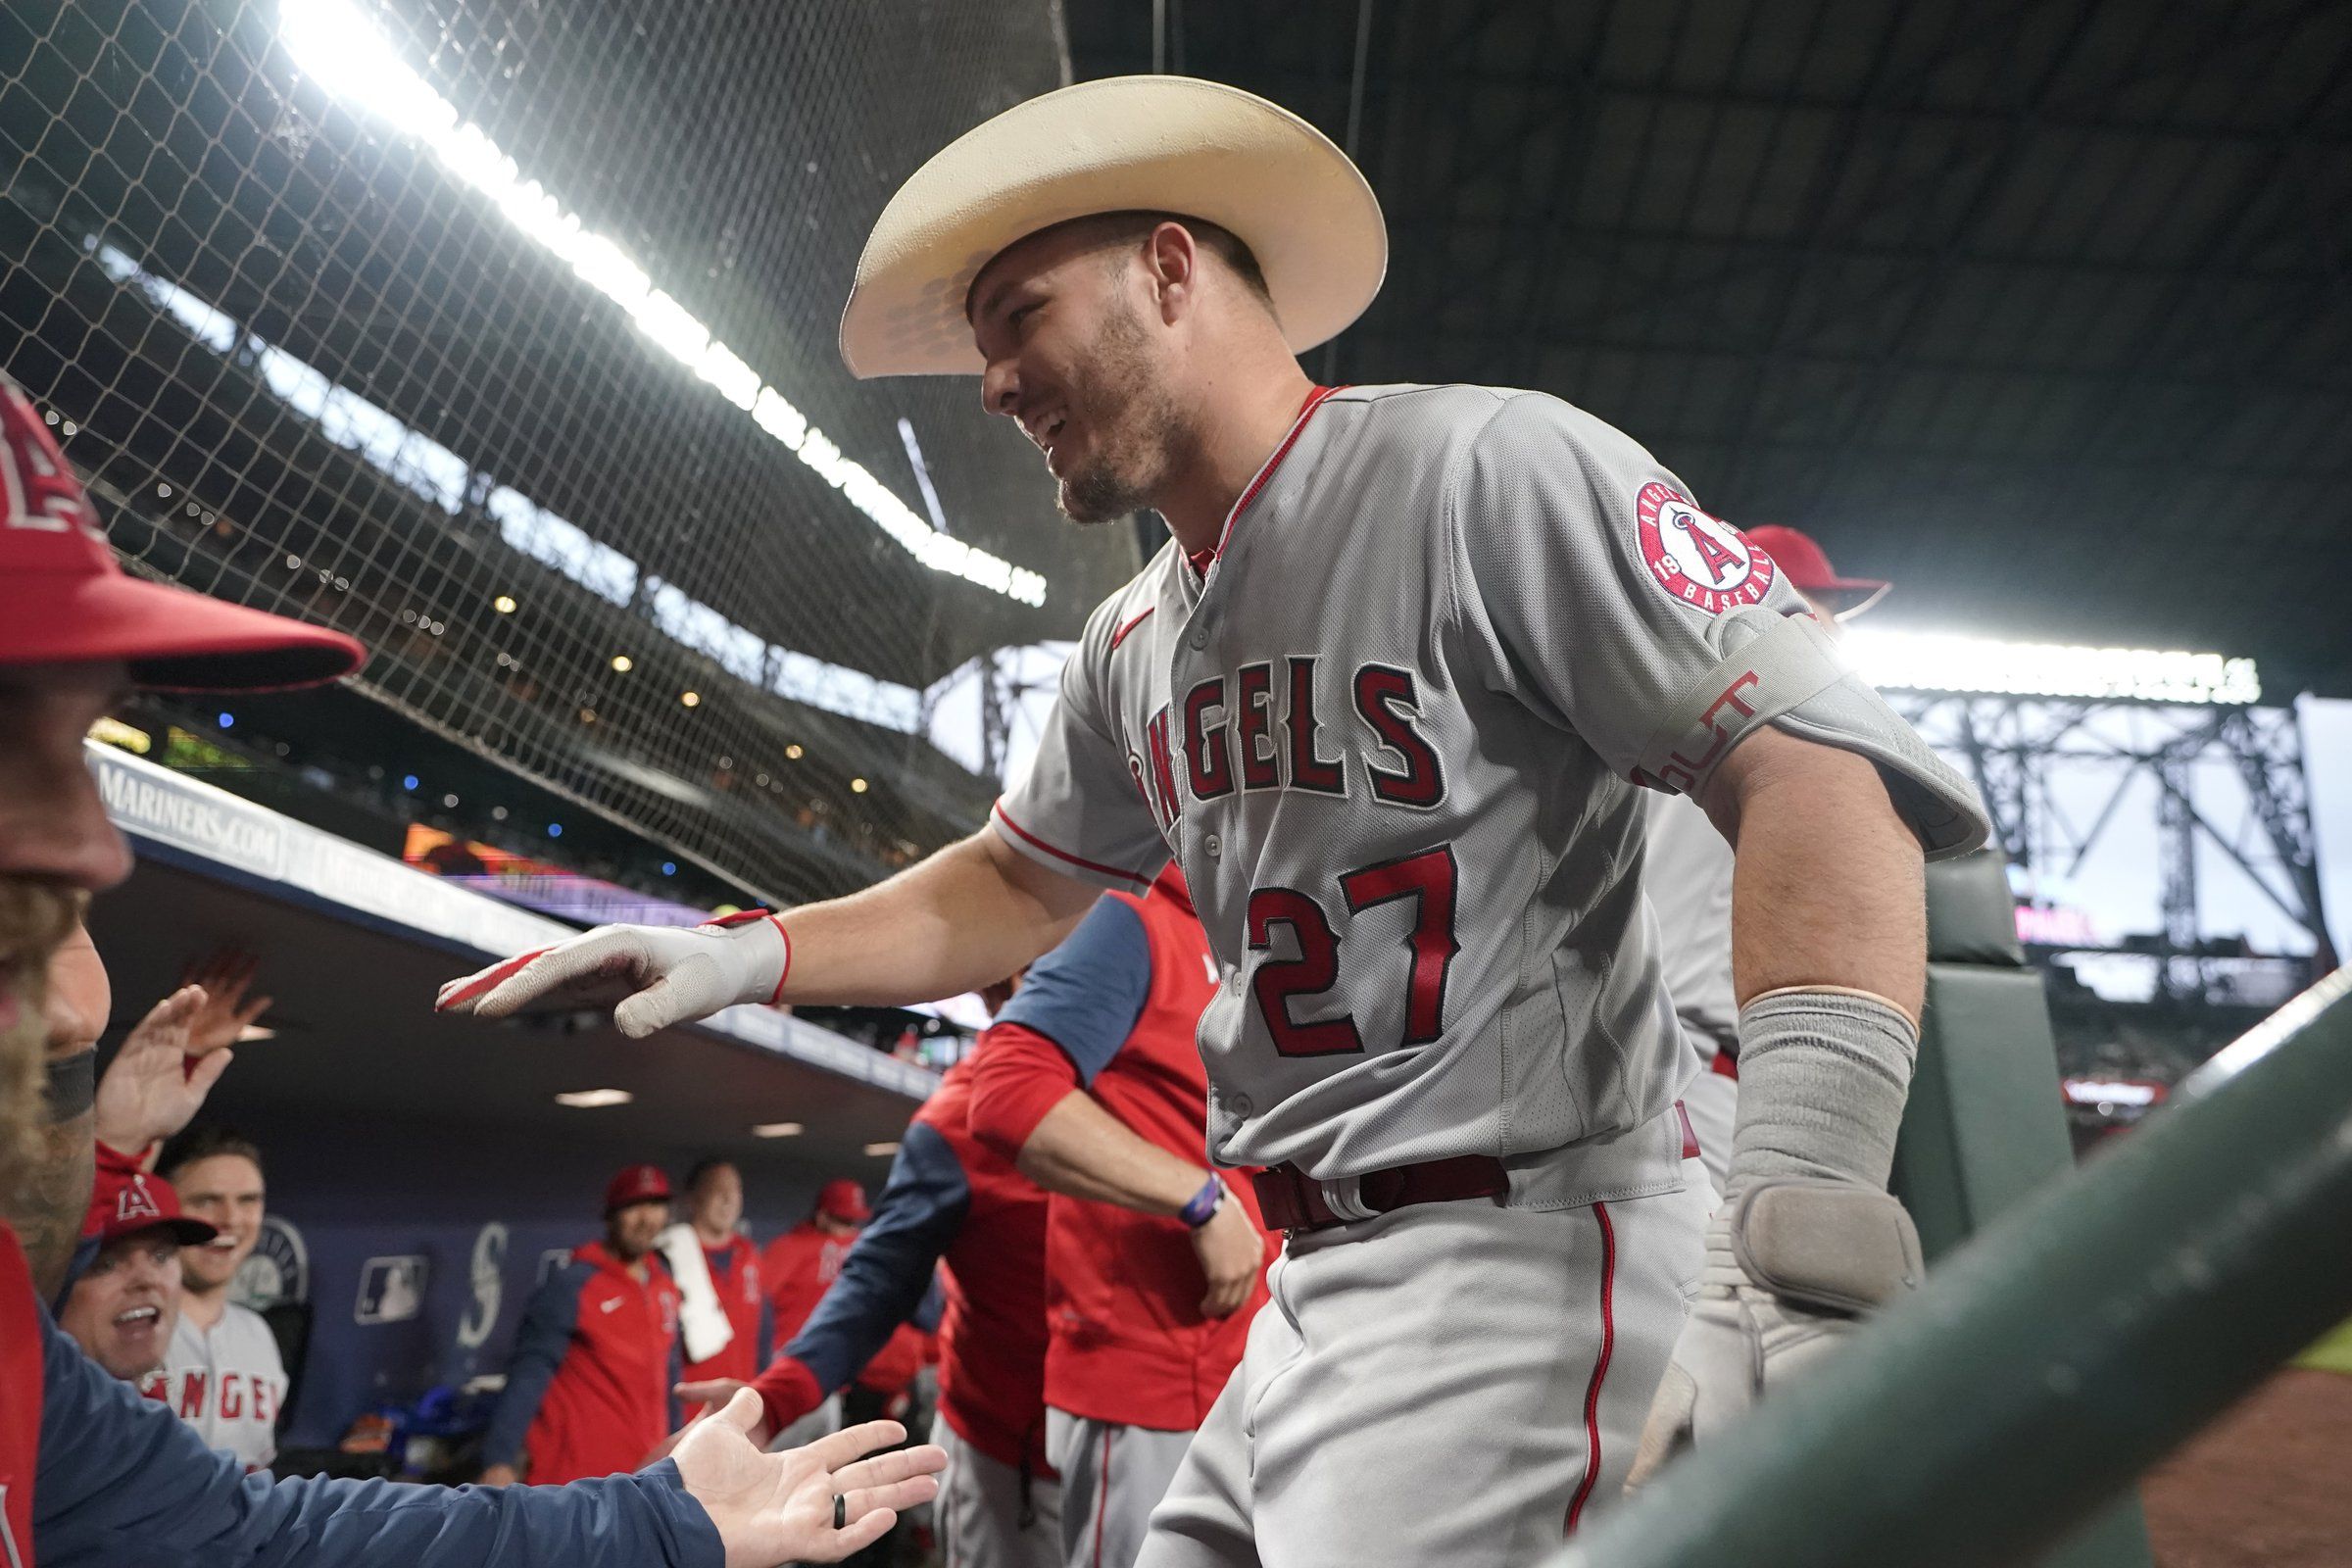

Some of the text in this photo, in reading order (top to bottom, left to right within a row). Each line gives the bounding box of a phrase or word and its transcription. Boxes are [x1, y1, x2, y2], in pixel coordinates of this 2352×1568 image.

[1653, 557, 1680, 580] 19
[1669, 507, 1745, 585] A
[1248, 843, 1460, 1057] 27
[117, 1175, 161, 1221] A
